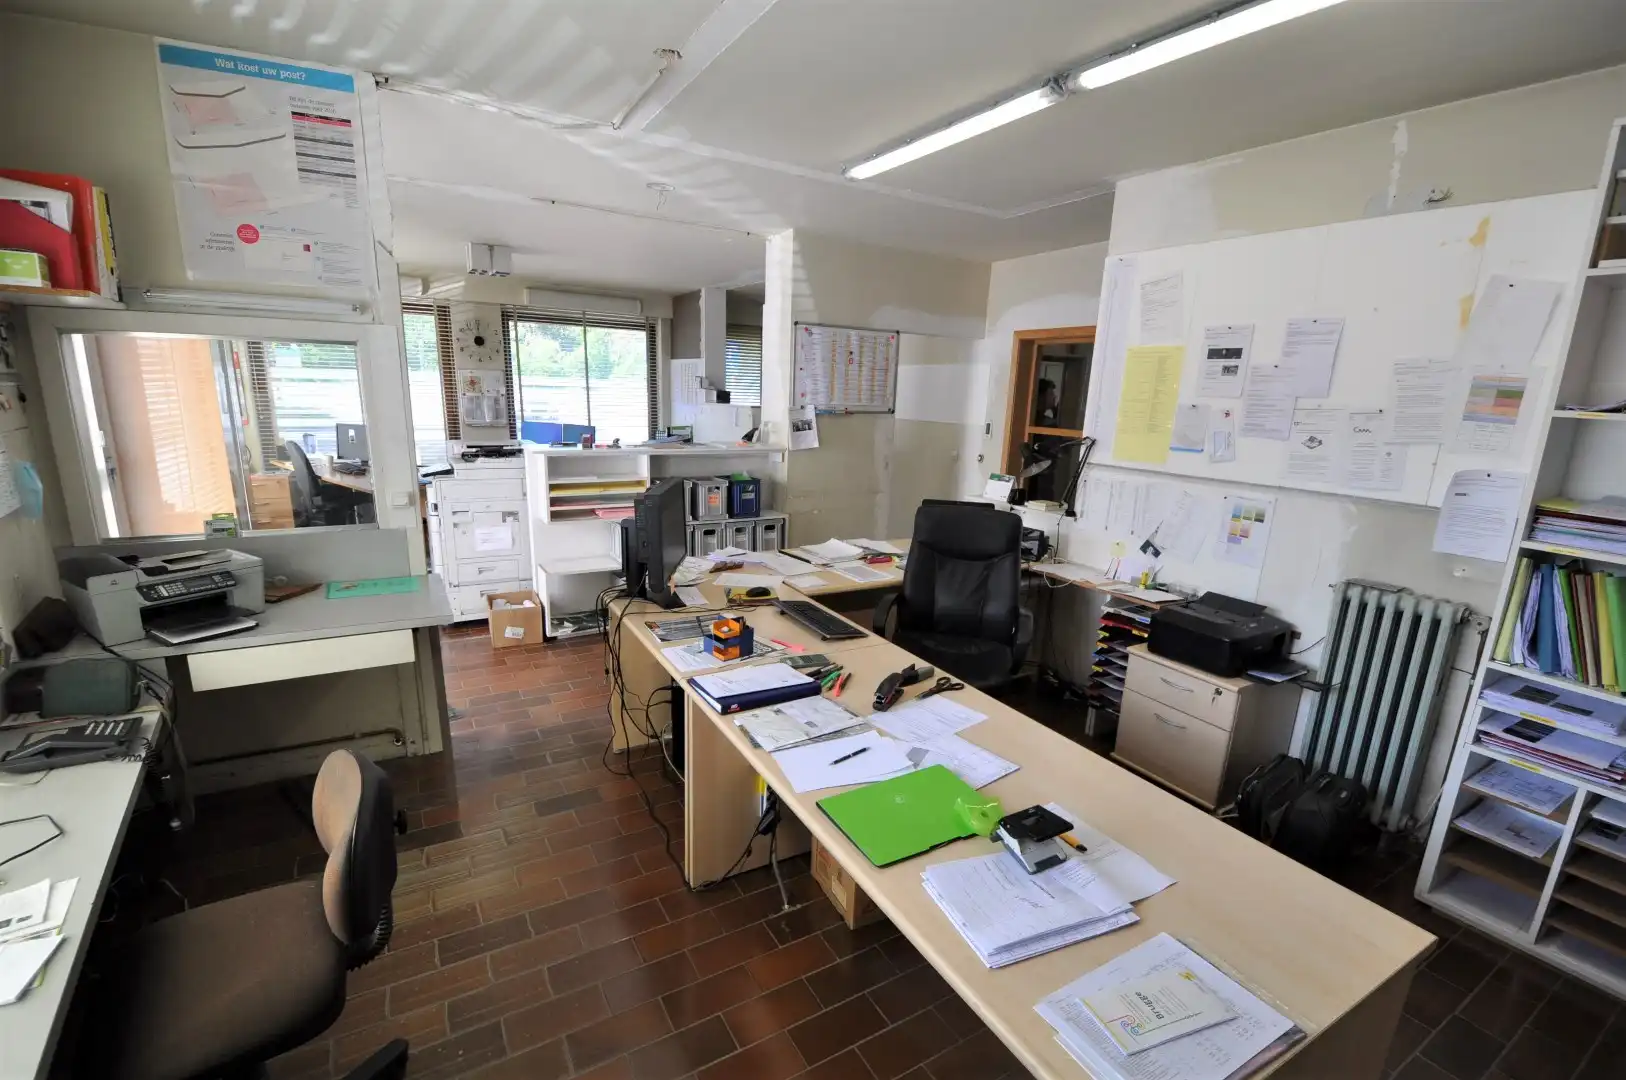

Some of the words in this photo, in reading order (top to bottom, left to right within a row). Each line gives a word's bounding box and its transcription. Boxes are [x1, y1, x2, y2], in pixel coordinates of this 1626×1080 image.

[214, 57, 235, 69] Wat
[237, 61, 259, 73] kost
[262, 68, 277, 76] uw
[280, 69, 306, 81] post?
[1134, 991, 1165, 1020] Brugge
